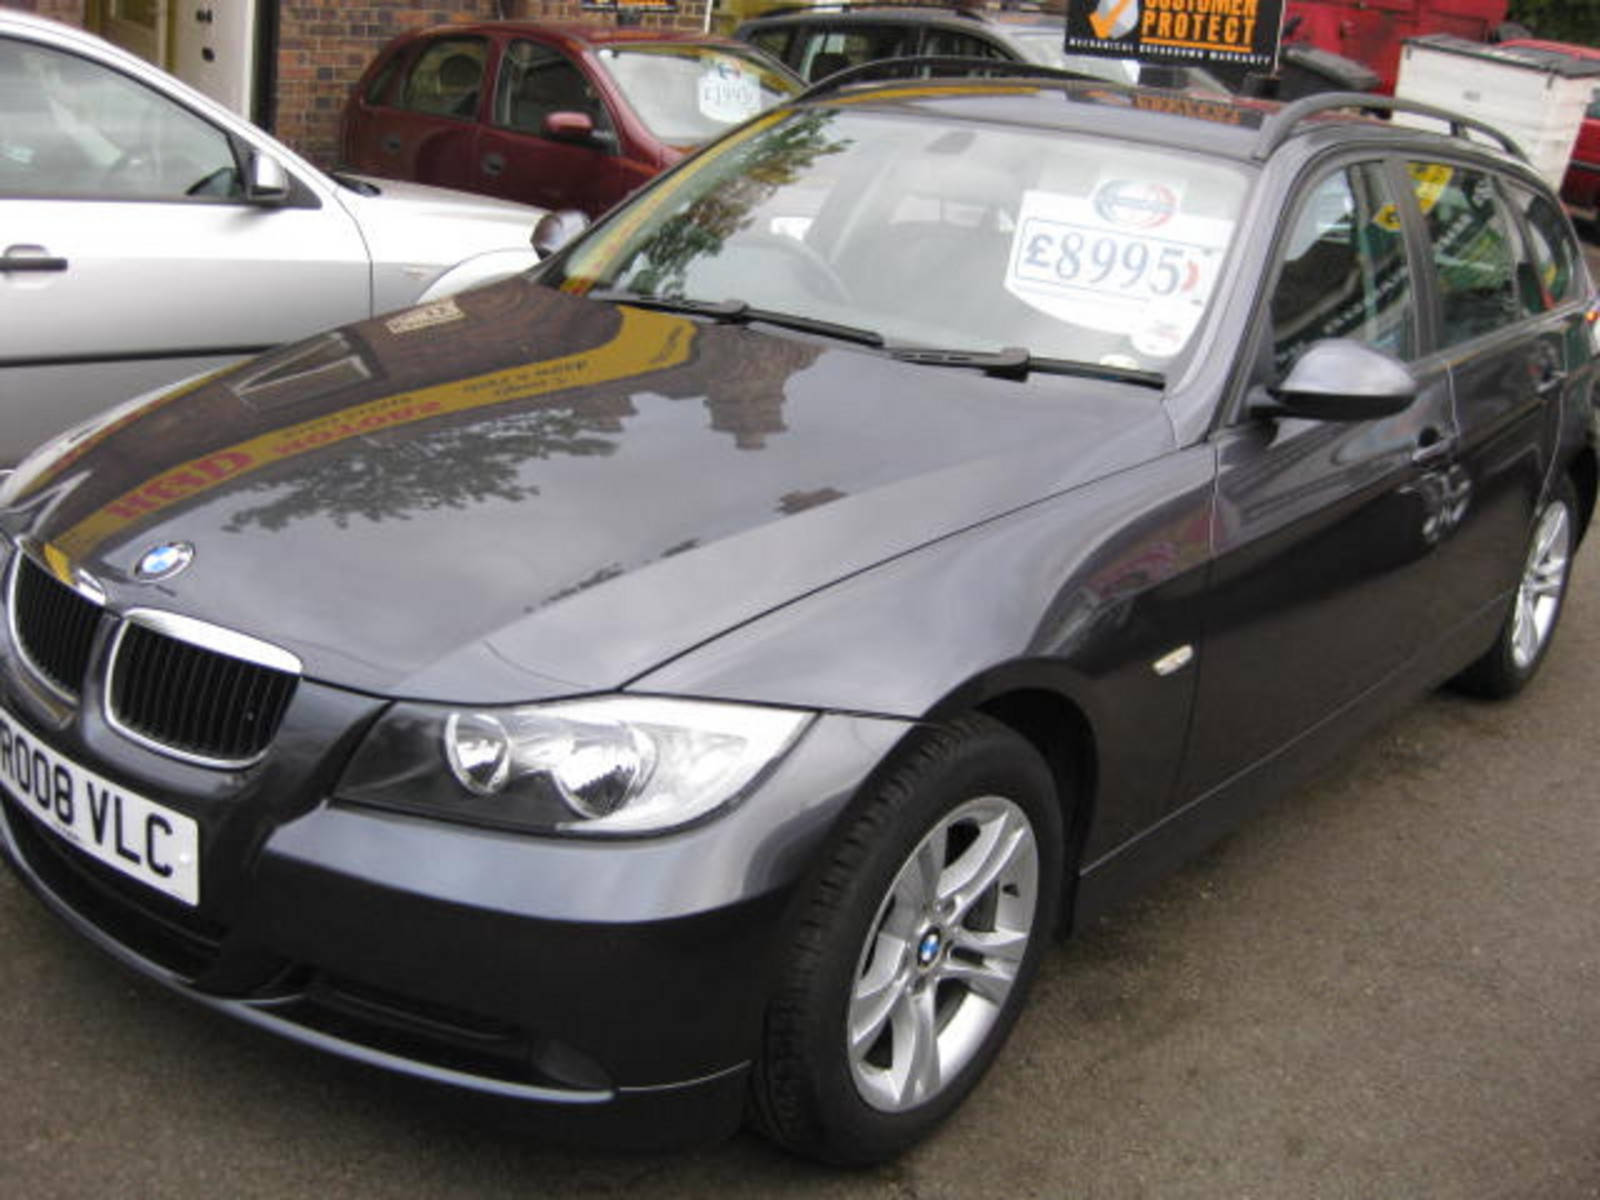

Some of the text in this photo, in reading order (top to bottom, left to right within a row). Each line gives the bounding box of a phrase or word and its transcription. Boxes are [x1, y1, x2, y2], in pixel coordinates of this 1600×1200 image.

[1141, 10, 1257, 45] PROTECT
[1024, 231, 1186, 296] £8995
[87, 780, 173, 878] VLC
